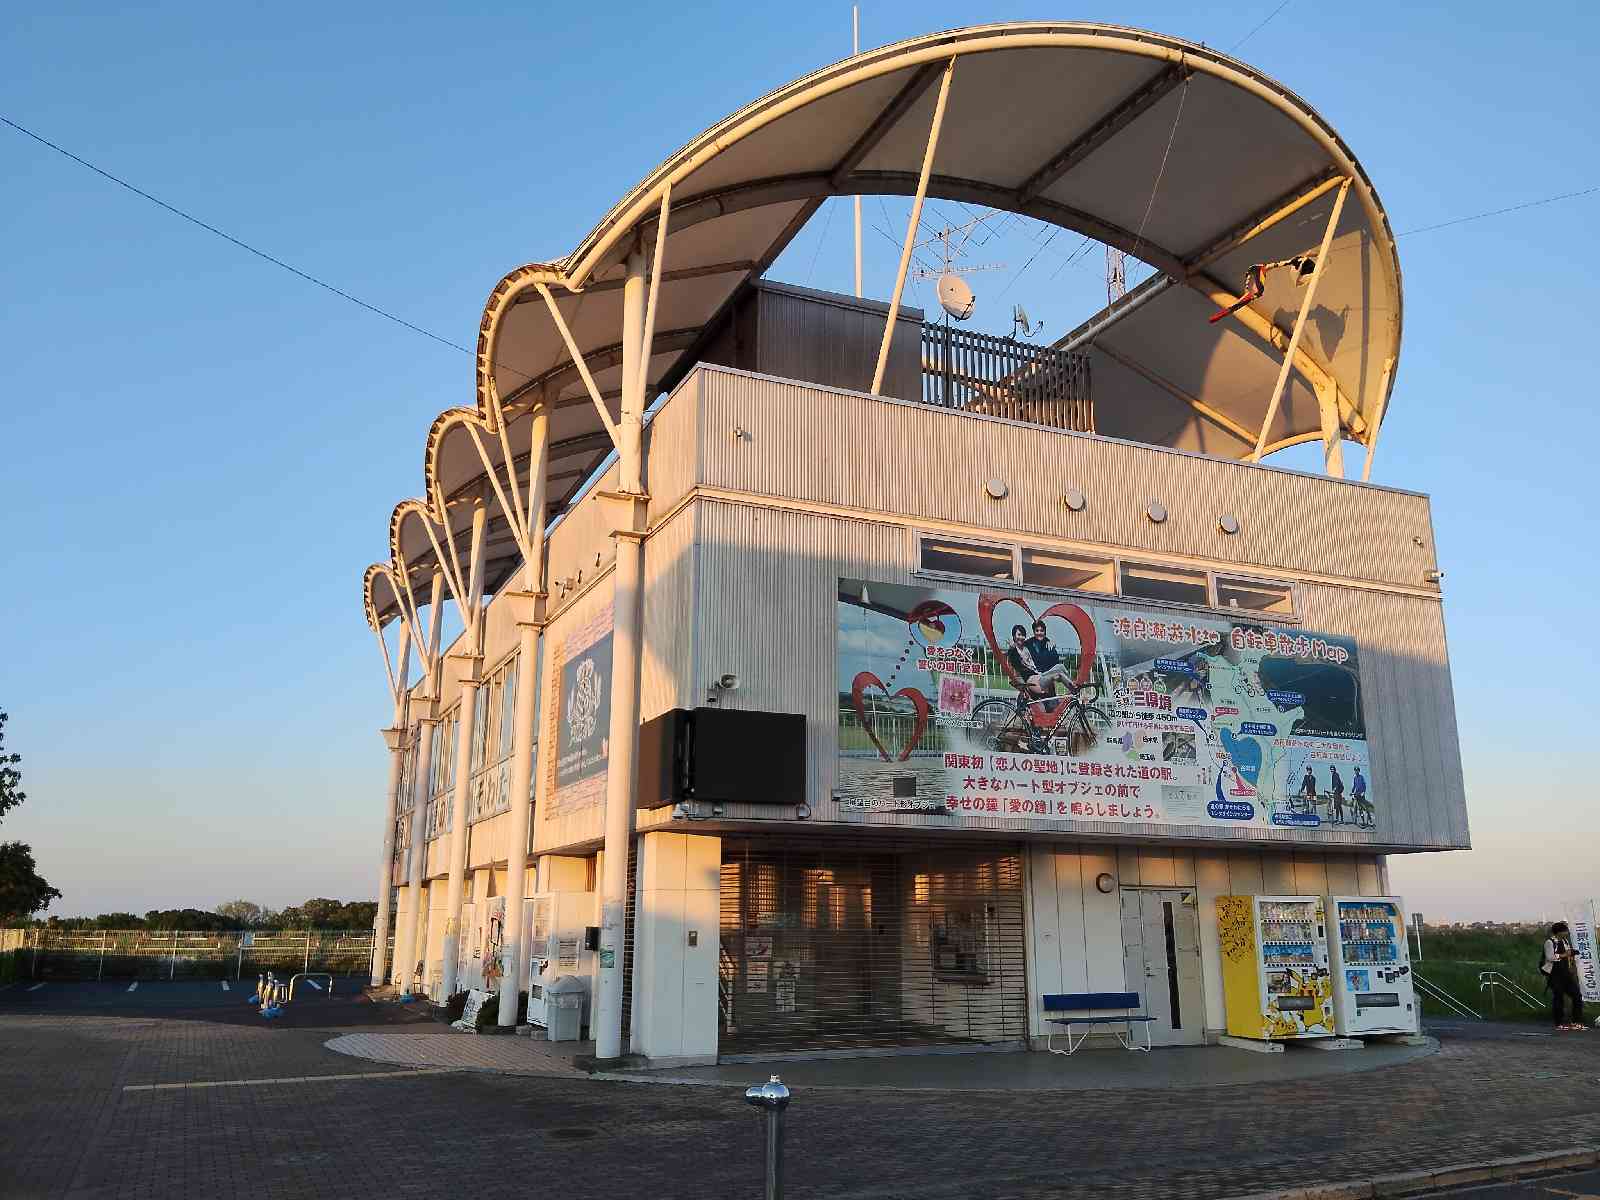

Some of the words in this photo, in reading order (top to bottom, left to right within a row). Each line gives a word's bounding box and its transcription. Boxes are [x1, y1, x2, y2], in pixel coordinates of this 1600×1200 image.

[926, 645, 974, 660] 愛をつなぐ
[1231, 627, 1348, 664] 自転車散歩Map
[1134, 691, 1172, 711] 三県境
[963, 776, 1141, 798] 大きなハート型オブジェの前で
